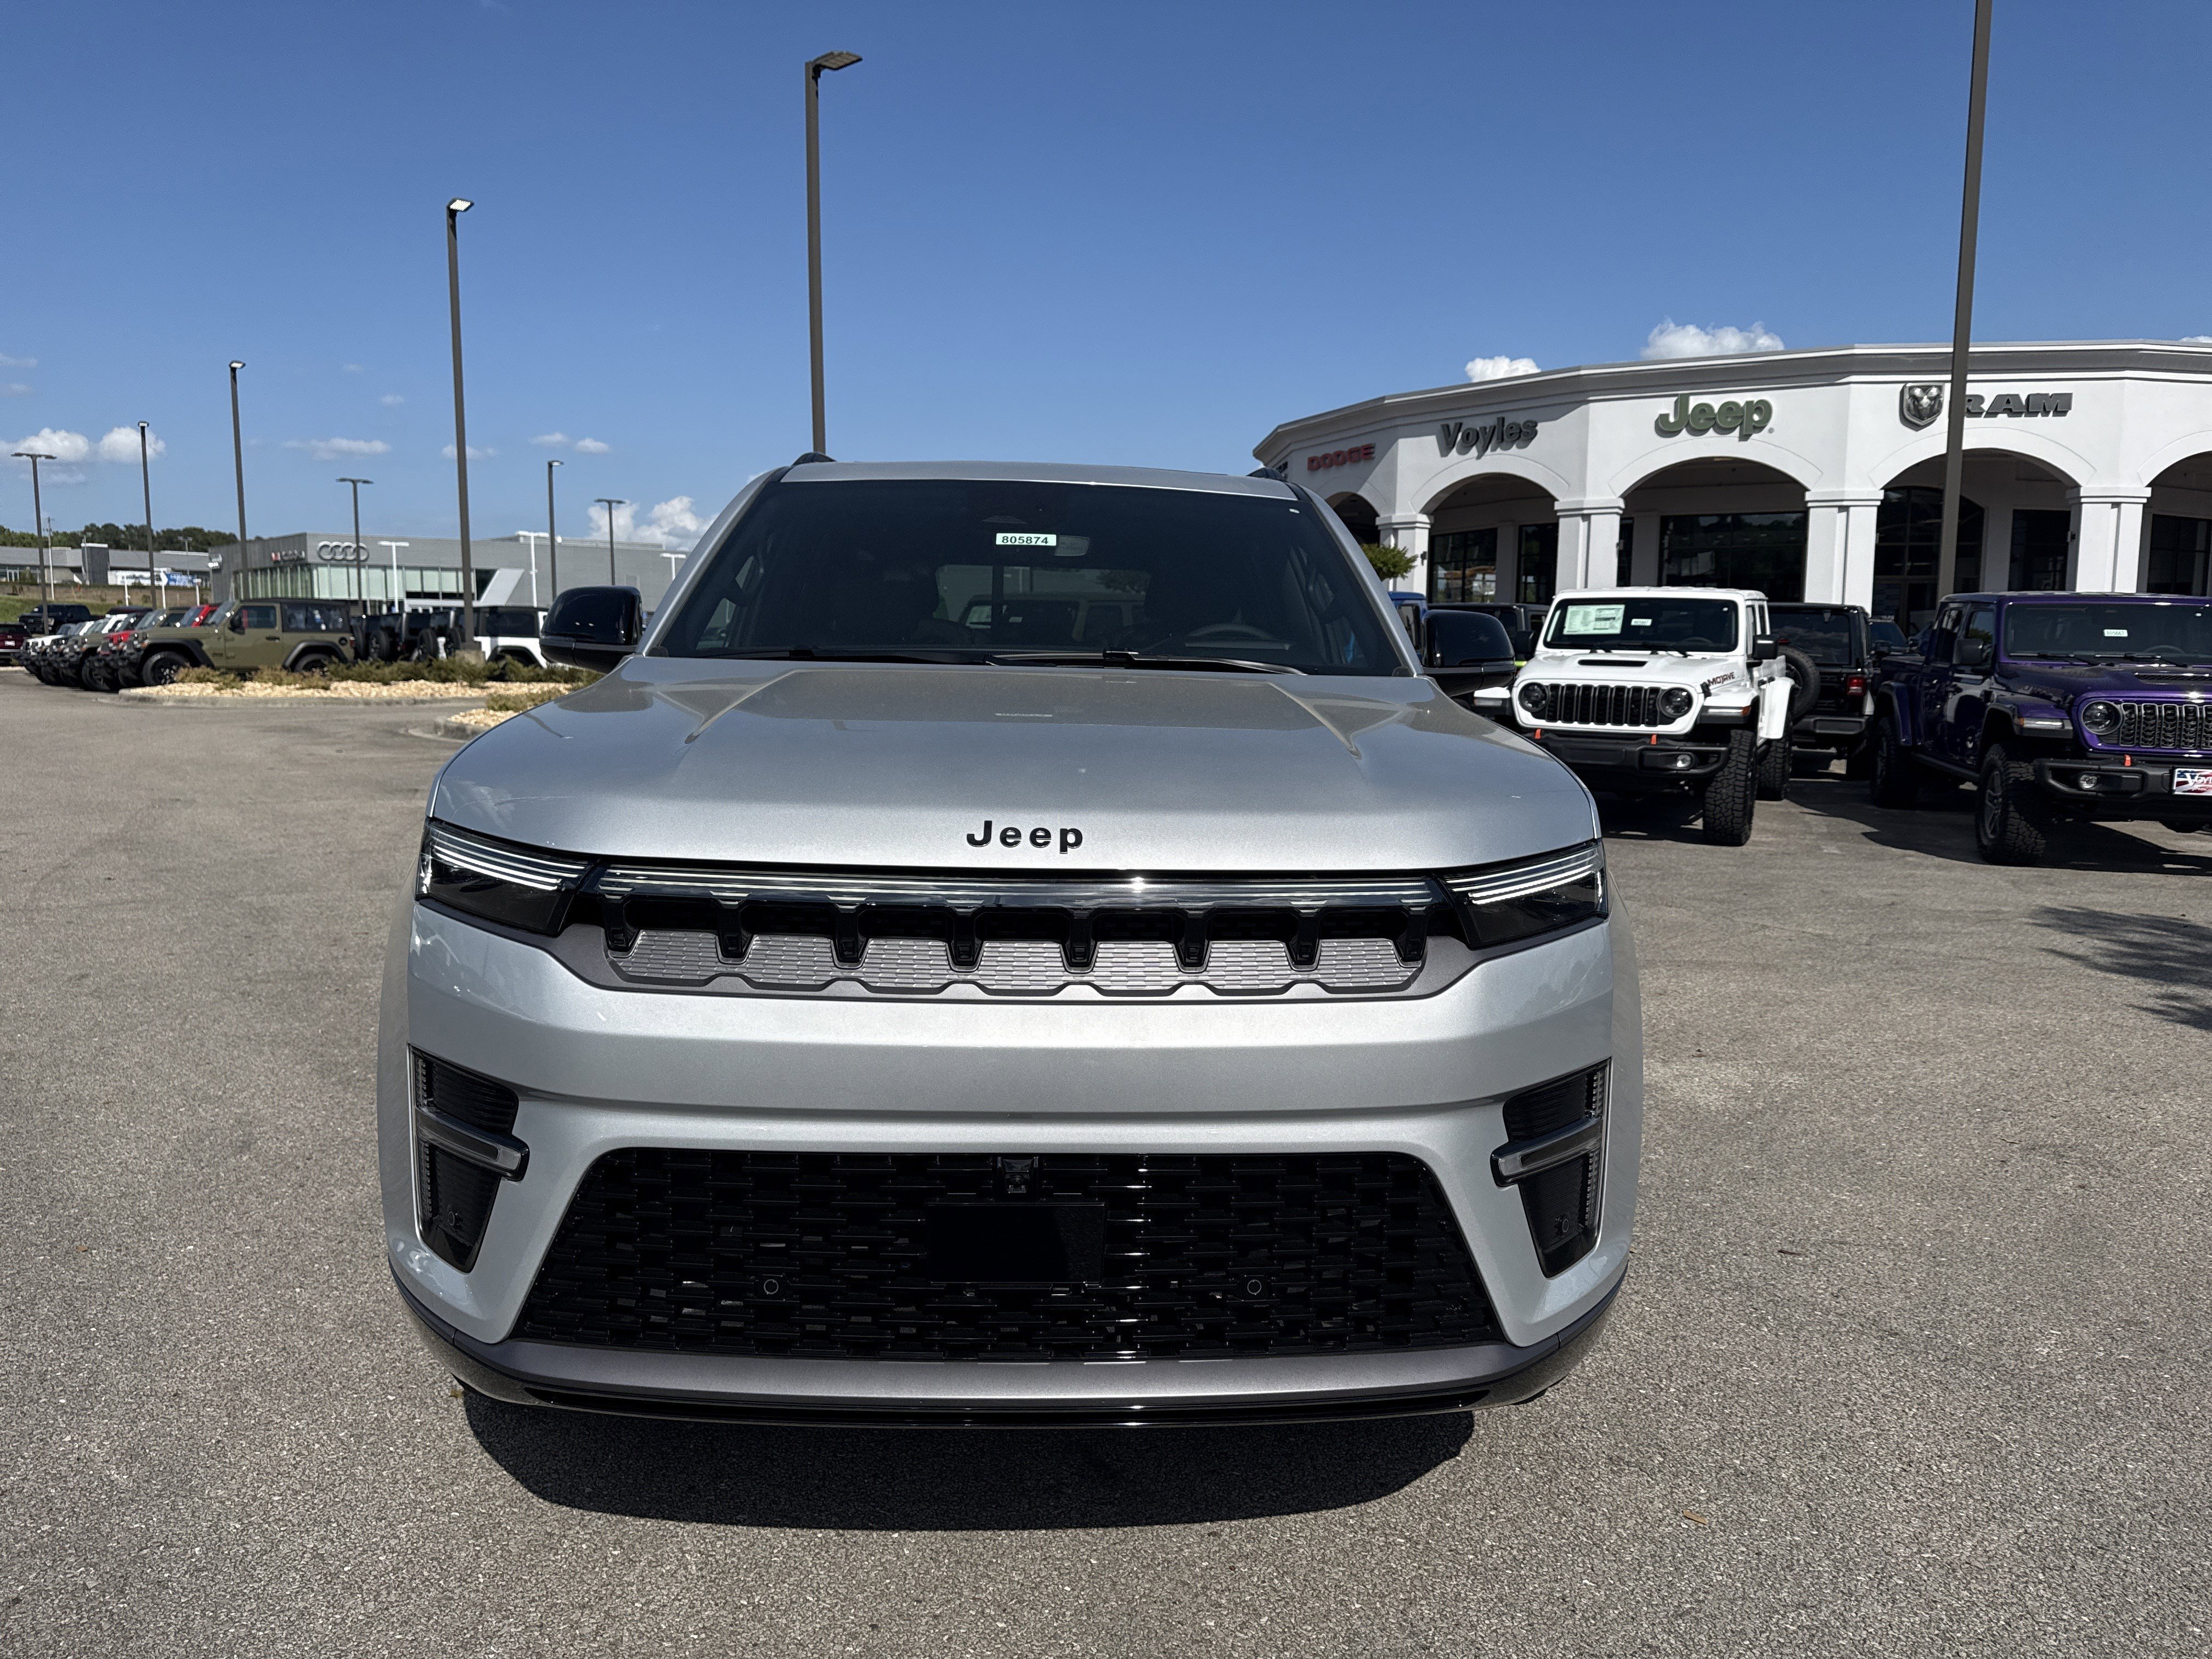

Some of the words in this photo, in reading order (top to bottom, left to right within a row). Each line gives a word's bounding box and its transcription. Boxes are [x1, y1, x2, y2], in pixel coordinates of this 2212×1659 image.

[1656, 393, 1773, 440] Jeep
[1440, 416, 1538, 460] Voyles
[1307, 443, 1376, 471] DODGE
[1001, 535, 1049, 545] 805874
[1707, 672, 1735, 686] MOJAVE
[966, 820, 1083, 854] Jeep
